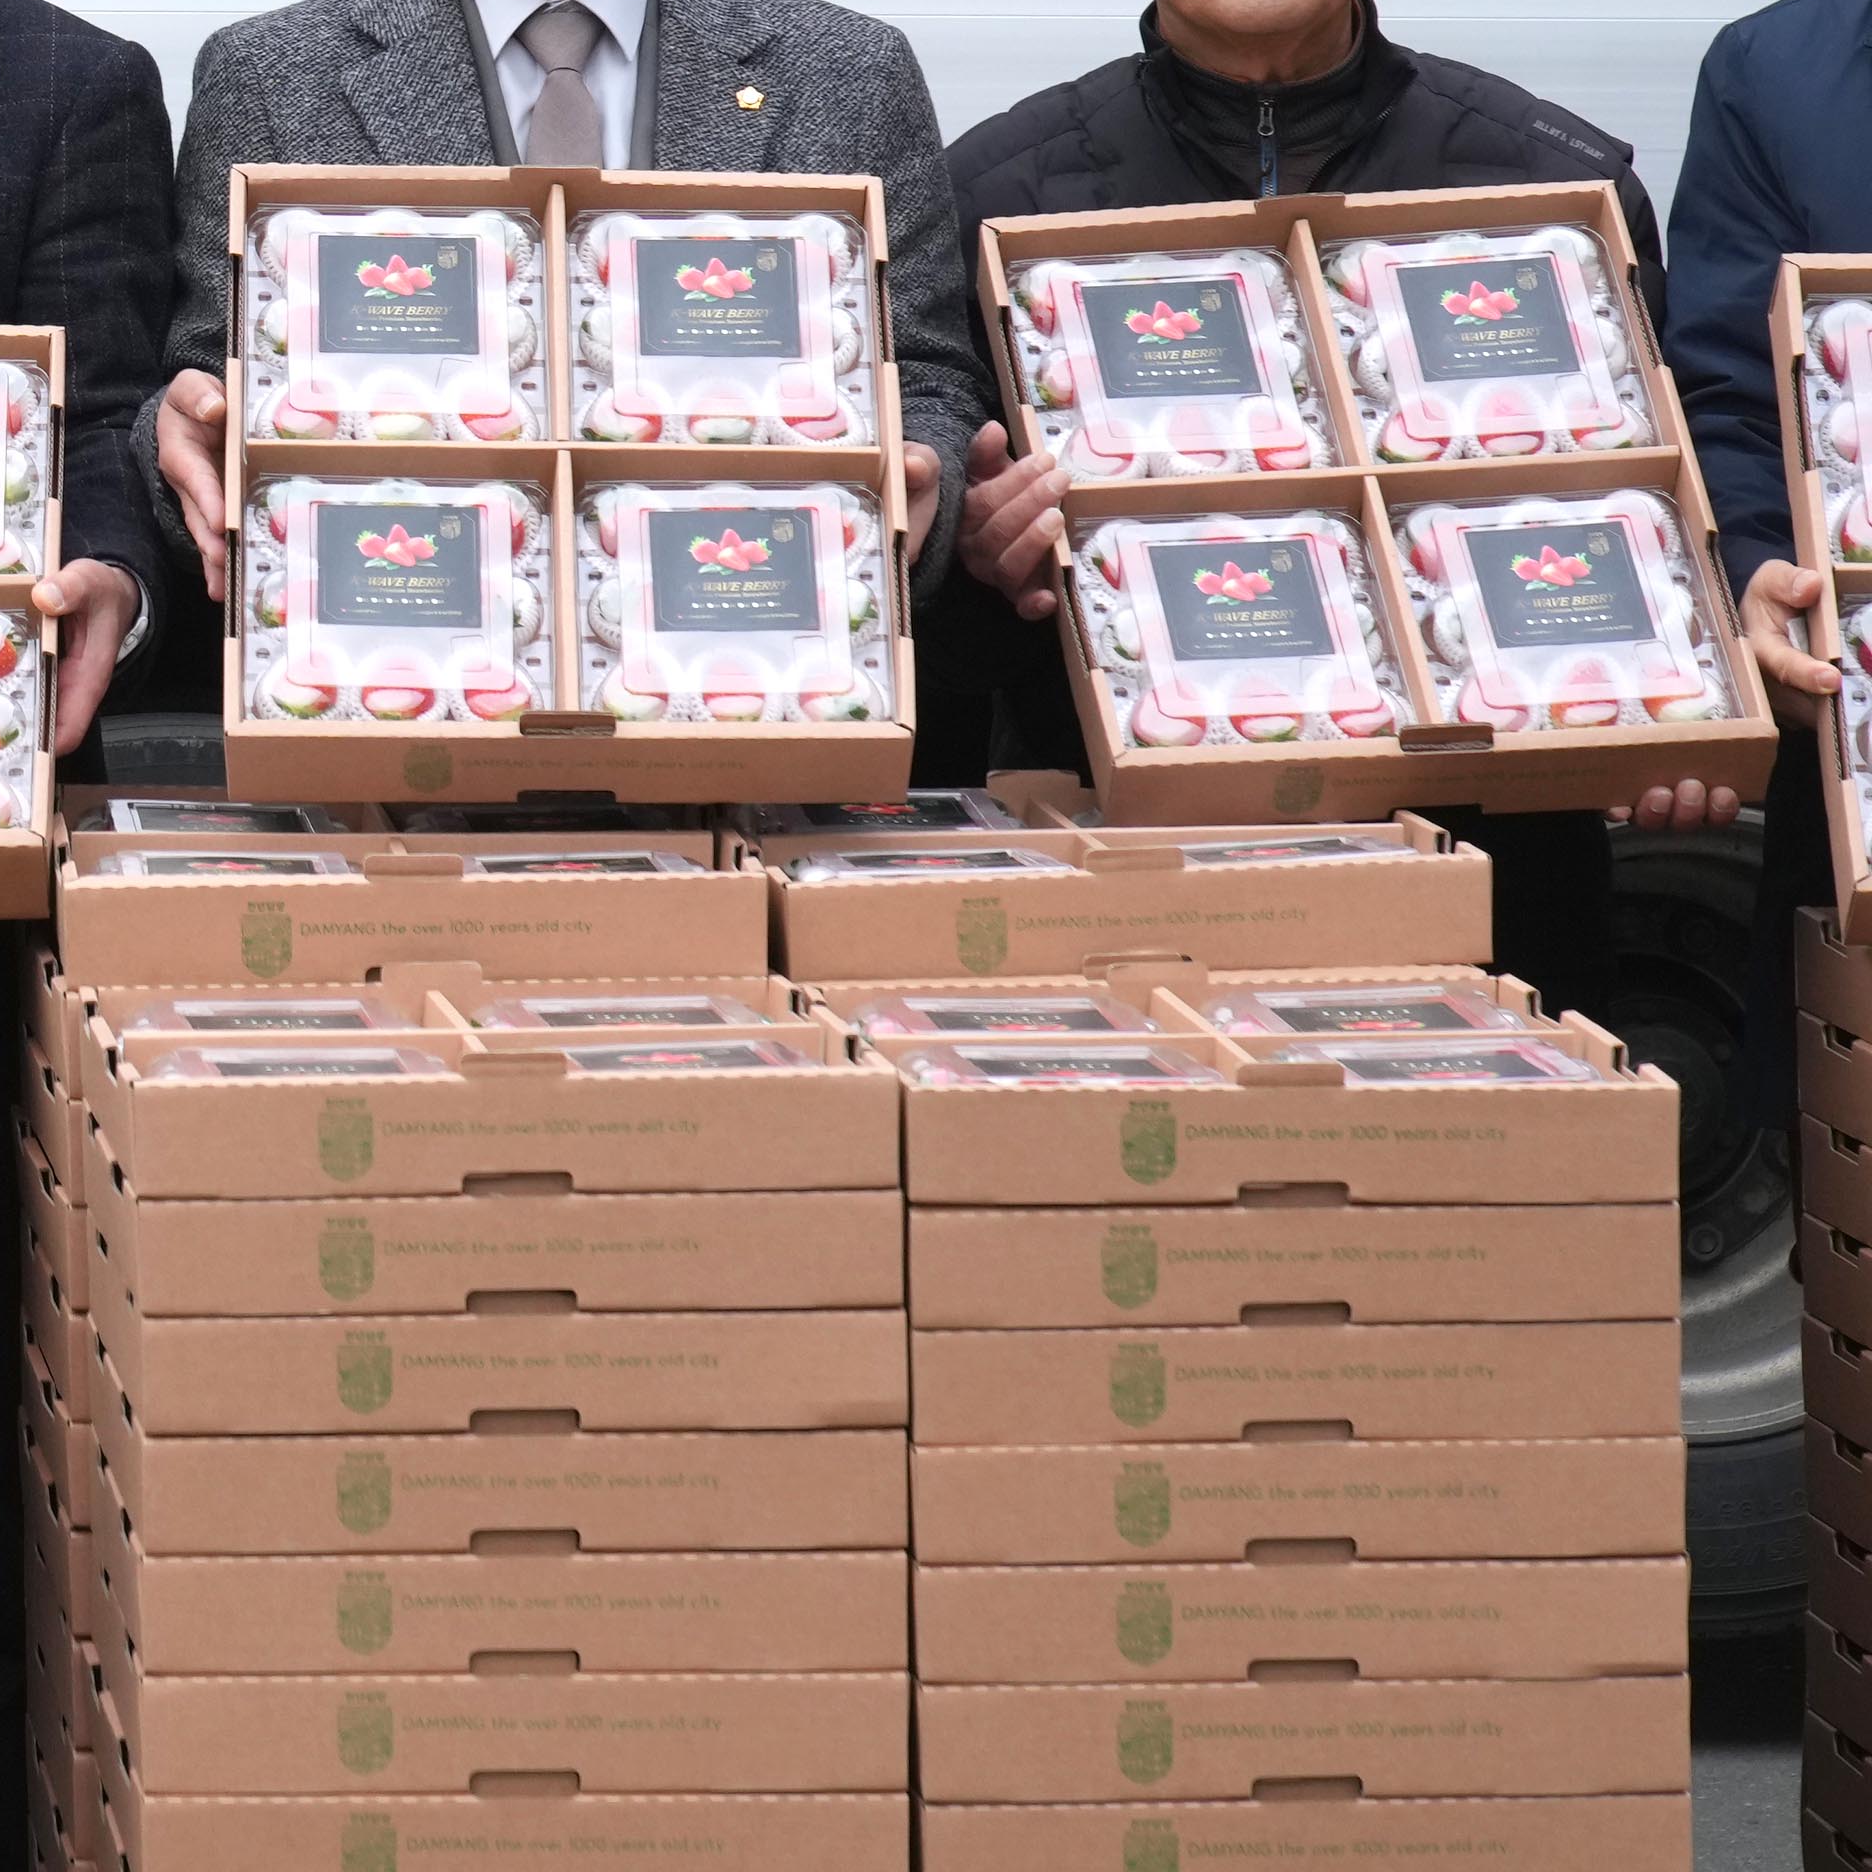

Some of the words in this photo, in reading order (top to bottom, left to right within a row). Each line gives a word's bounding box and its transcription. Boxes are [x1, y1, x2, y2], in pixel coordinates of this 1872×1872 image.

[405, 306, 454, 316] BERRY
[726, 308, 773, 318] BERRY
[1499, 326, 1543, 339] BERRY
[1182, 346, 1227, 359] BERRY
[407, 577, 454, 588] BERRY
[740, 580, 789, 591] BERRY
[1571, 592, 1618, 606] BERRY
[1253, 608, 1298, 621] BERRY
[1016, 915, 1092, 929] DAMYANG
[1097, 915, 1121, 927] the
[1127, 916, 1156, 927] over
[1164, 911, 1199, 925] 1000
[1206, 911, 1245, 925] years
[1250, 908, 1274, 921] old
[1279, 907, 1306, 920] city
[300, 920, 376, 935] DAMYANG
[382, 922, 406, 934] the
[412, 924, 443, 935] over
[448, 919, 484, 934] 1000
[490, 922, 529, 935] years
[535, 918, 559, 933] old
[564, 919, 593, 934] city
[382, 1121, 464, 1137] DAMYANG
[470, 1121, 497, 1134] the
[503, 1125, 536, 1134] over
[543, 1120, 581, 1136] 1000
[588, 1123, 630, 1136] years
[637, 1120, 664, 1134] old
[668, 1120, 699, 1135] city
[1185, 1124, 1269, 1140] DAMYANG
[1275, 1125, 1303, 1139] the
[1309, 1129, 1343, 1139] over
[1350, 1125, 1388, 1140] 1000
[1393, 1129, 1438, 1142] years
[1444, 1126, 1471, 1139] old
[1475, 1126, 1505, 1141] city
[402, 1355, 485, 1369] DAMYANG
[490, 1355, 518, 1367] the
[523, 1358, 556, 1367] over
[565, 1353, 602, 1368] 1000
[609, 1356, 651, 1369] years
[657, 1353, 685, 1367] old
[689, 1353, 719, 1369] city
